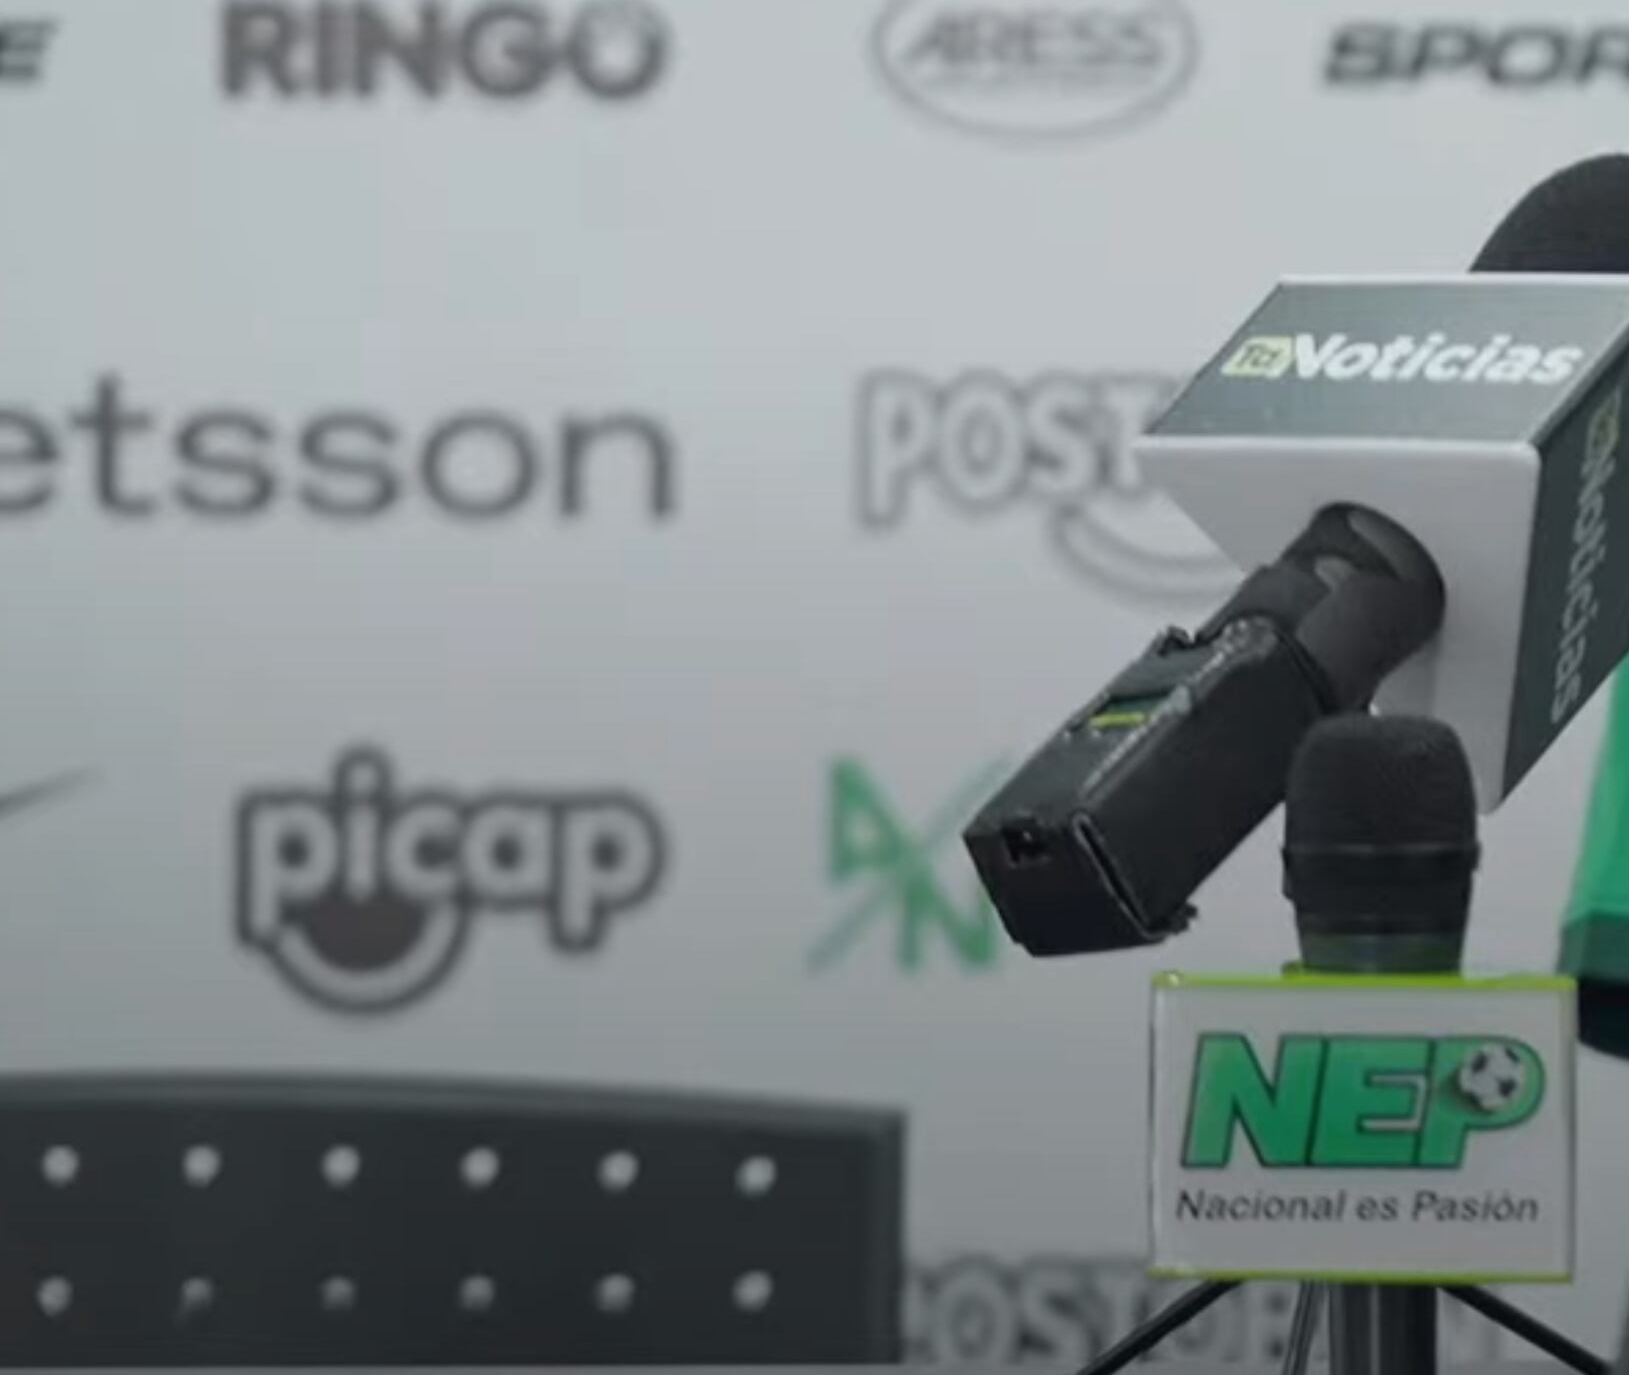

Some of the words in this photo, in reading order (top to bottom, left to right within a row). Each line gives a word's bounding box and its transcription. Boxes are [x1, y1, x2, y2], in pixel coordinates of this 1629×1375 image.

[1266, 332, 1583, 384] Noticias
[1551, 452, 1616, 725] Noticias
[236, 746, 670, 952] picap
[1180, 1034, 1547, 1170] NEP
[1176, 1188, 1346, 1224] Nacional
[1356, 1198, 1399, 1224] es
[1411, 1187, 1539, 1224] Pasión
